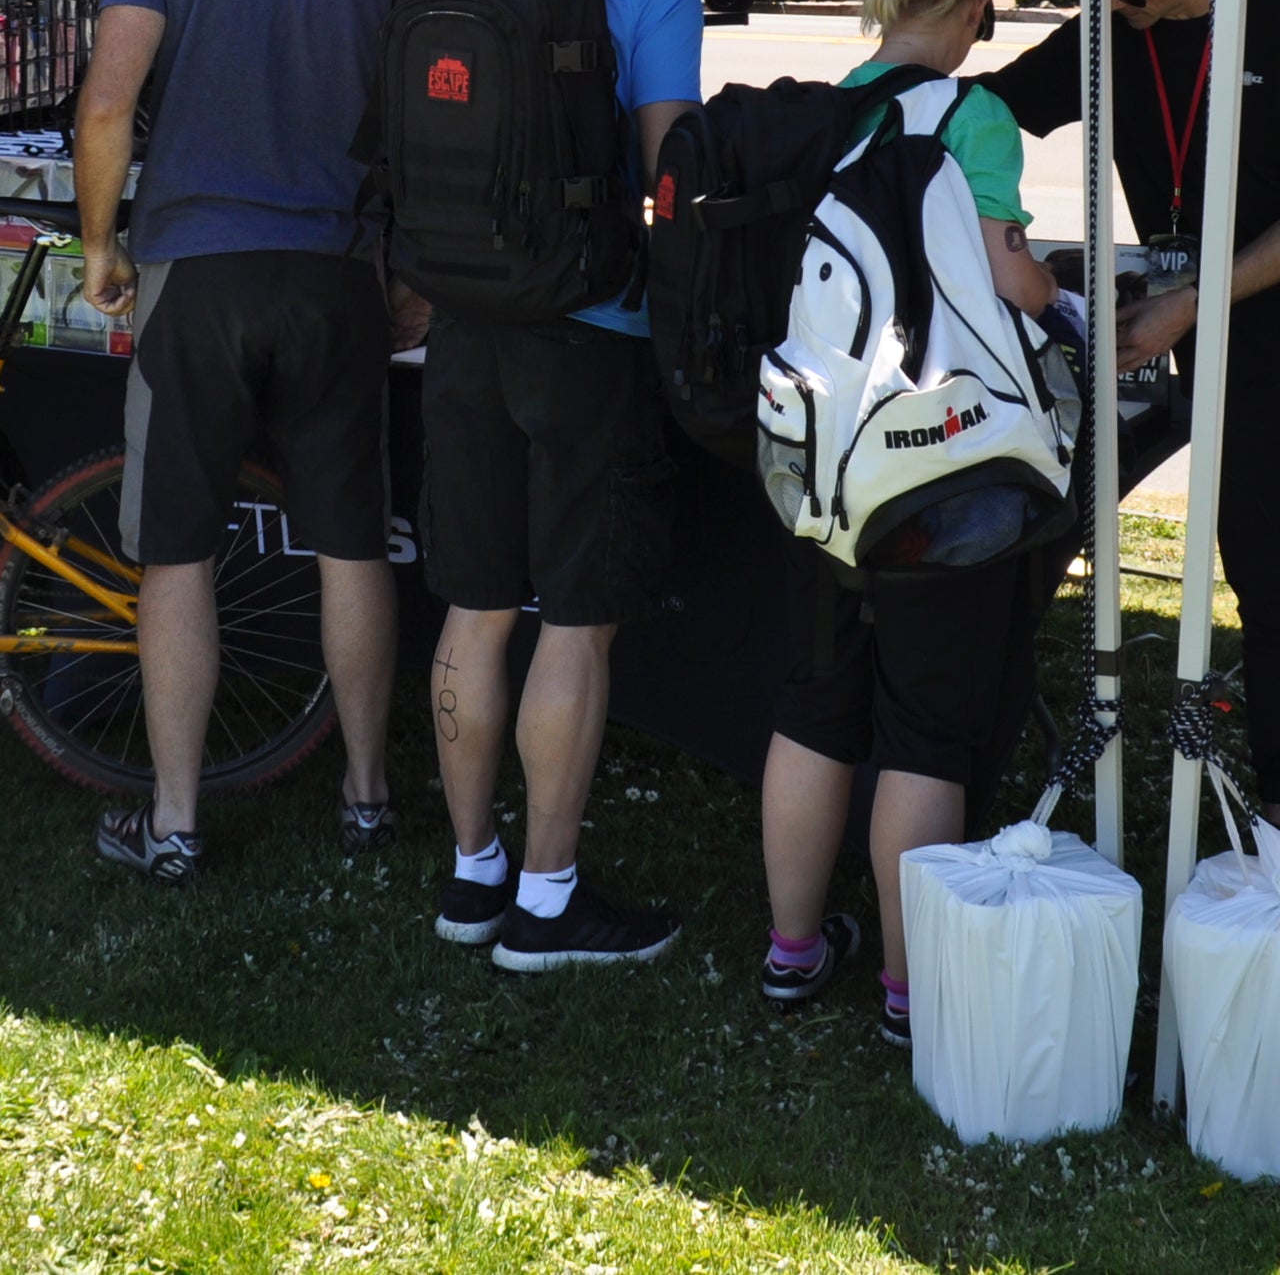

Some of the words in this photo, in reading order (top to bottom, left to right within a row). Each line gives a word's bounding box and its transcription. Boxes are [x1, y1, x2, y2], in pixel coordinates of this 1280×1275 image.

[429, 70, 469, 93] ESCAPE
[1160, 251, 1189, 271] VIP
[1139, 368, 1158, 383] IN
[884, 402, 989, 449] IRONMAN
